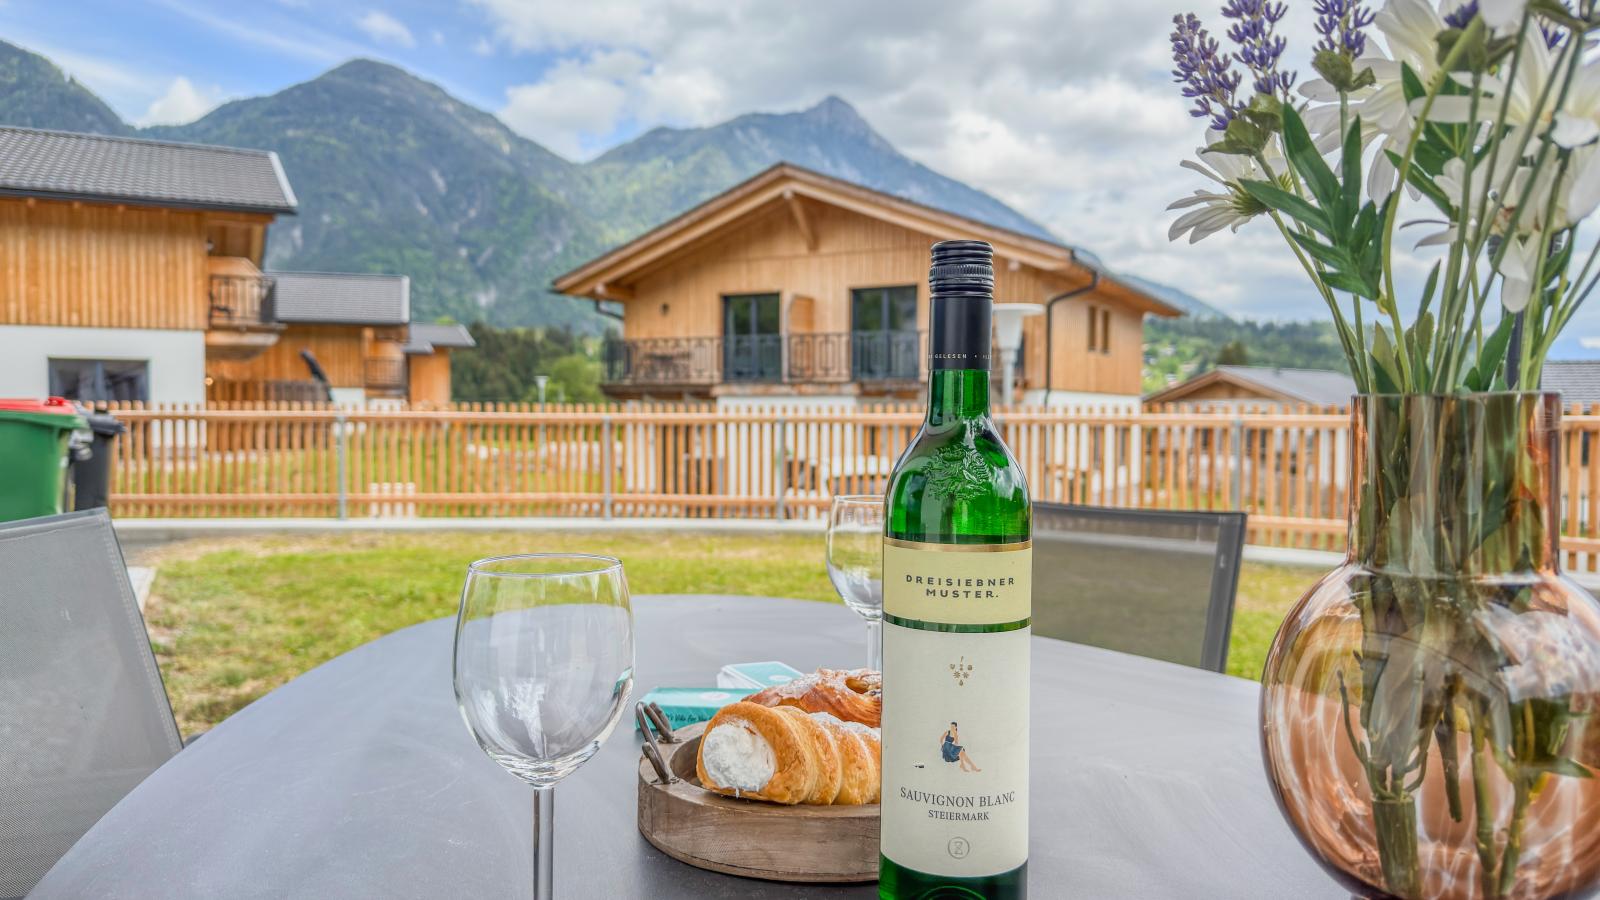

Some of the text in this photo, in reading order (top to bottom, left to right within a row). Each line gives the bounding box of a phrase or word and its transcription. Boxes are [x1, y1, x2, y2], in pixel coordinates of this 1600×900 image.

[905, 574, 1015, 587] DREISIEBNER
[925, 588, 999, 599] MUSTER.
[900, 786, 1015, 808] SAUVIGNON BLANC
[928, 809, 990, 821] STEIERMARK
